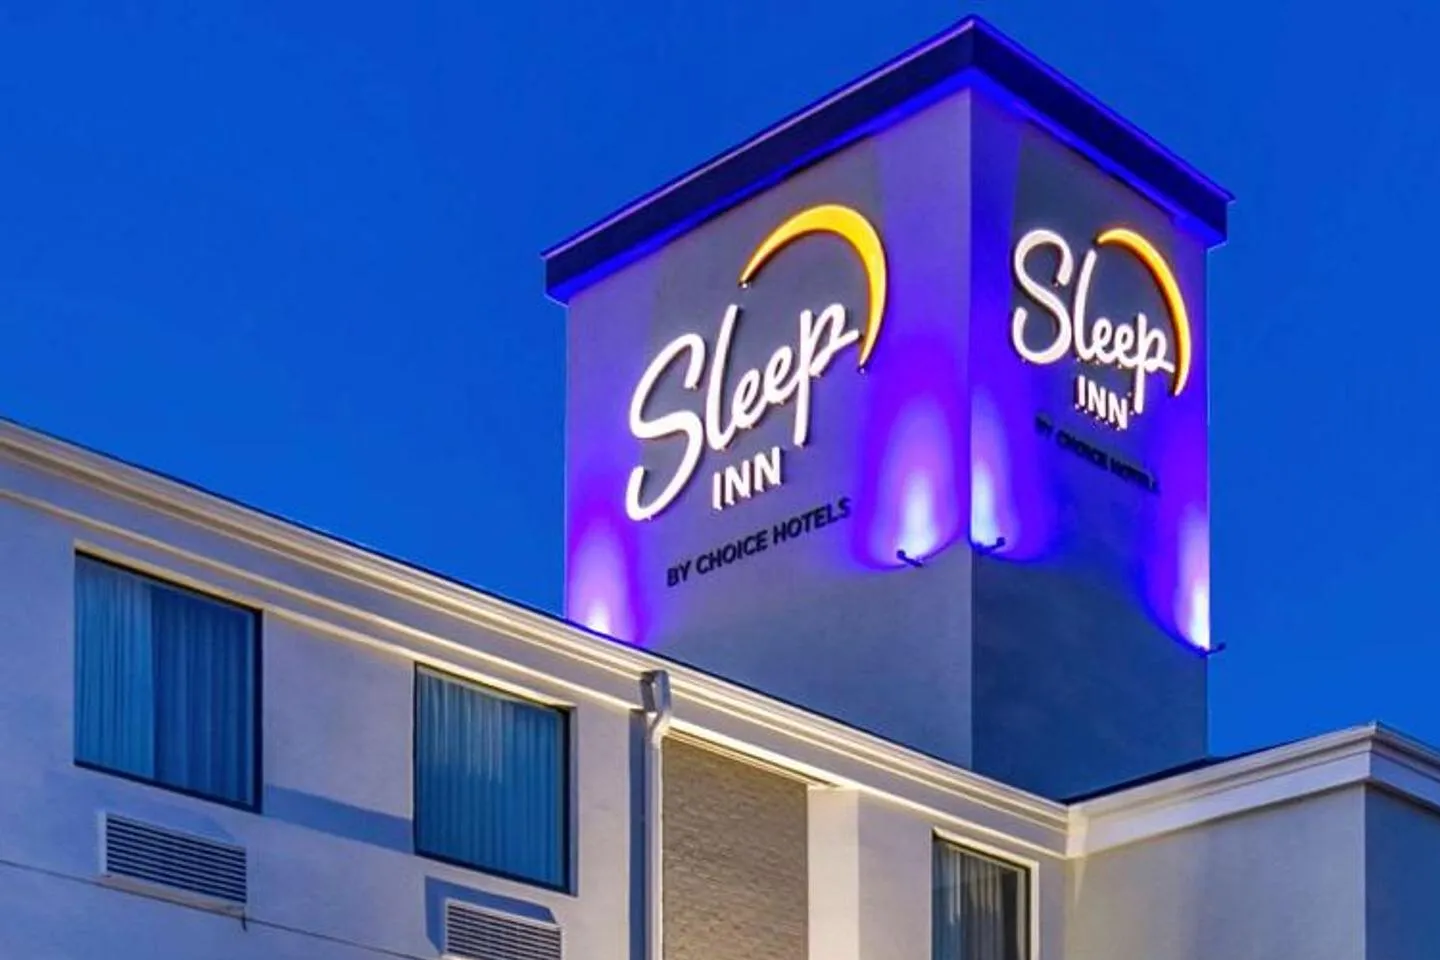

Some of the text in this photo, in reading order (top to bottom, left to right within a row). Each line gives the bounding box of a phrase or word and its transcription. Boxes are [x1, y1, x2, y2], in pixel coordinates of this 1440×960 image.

[1012, 229, 1175, 415] Sleep
[626, 303, 860, 520] Sleep
[1076, 375, 1128, 430] INN
[711, 446, 782, 510] INN
[666, 497, 851, 587] BY CHOICE HOTELS
